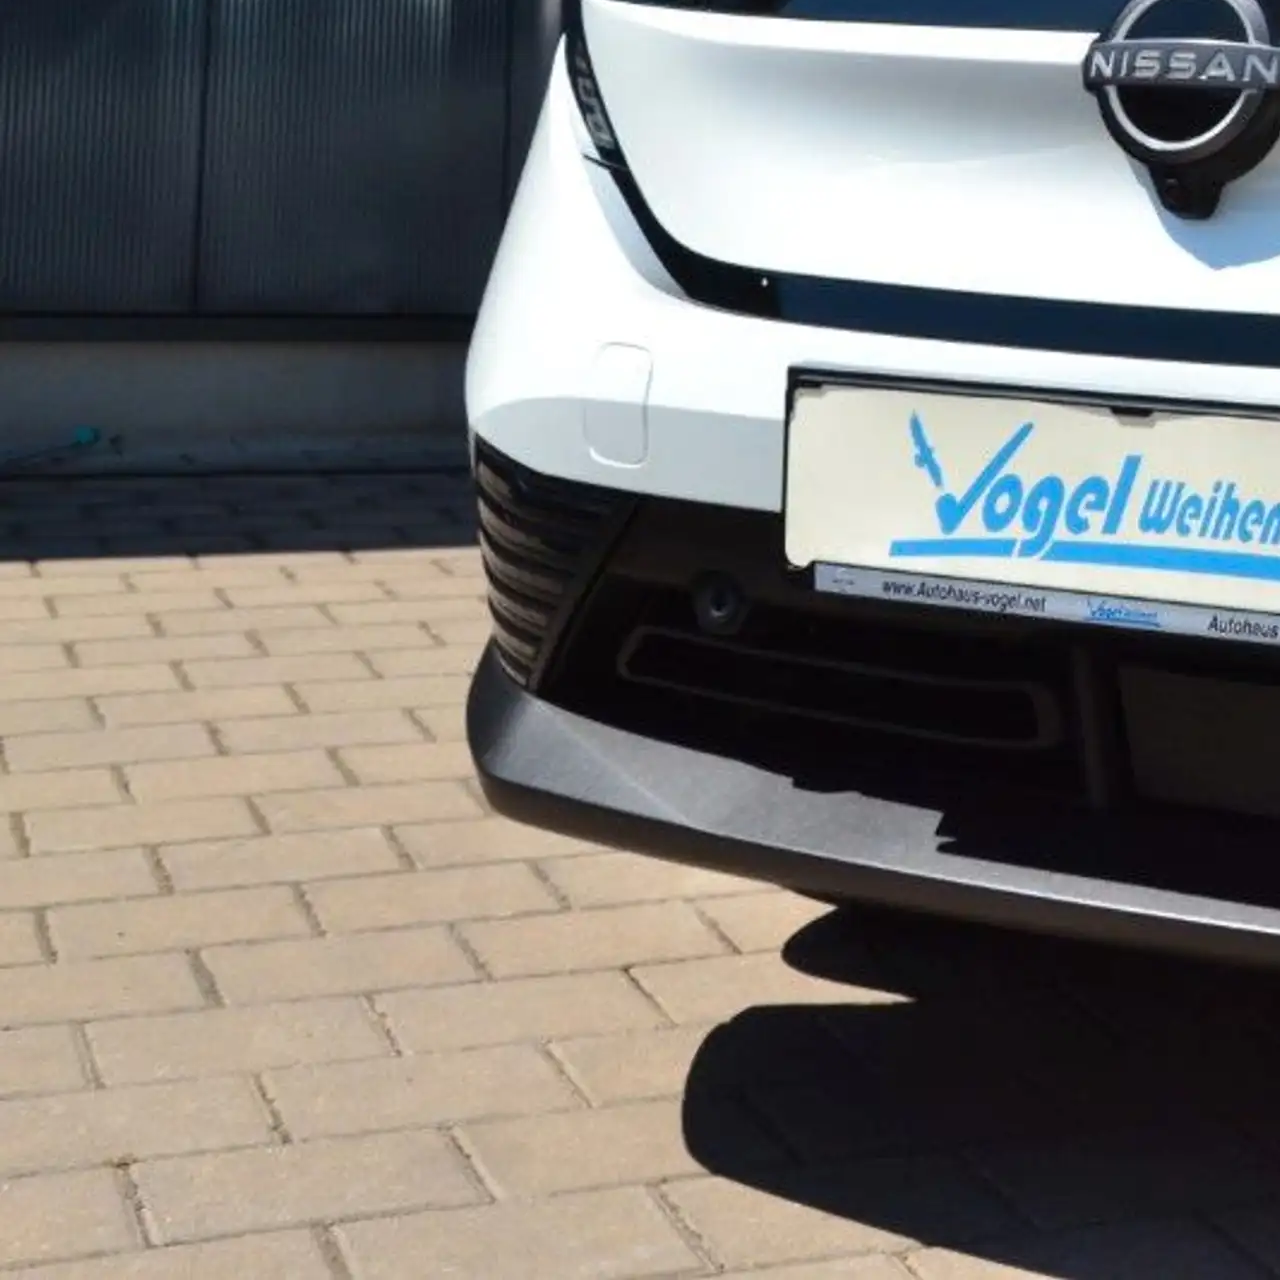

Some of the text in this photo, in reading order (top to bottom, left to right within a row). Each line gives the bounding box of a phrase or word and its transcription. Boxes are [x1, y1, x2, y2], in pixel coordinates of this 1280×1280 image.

[1090, 49, 1278, 84] NISSAN
[909, 410, 1142, 559] Vogel
[881, 580, 1047, 612] www.Autohaus-vogel.net
[1208, 615, 1279, 639] Autohaus
